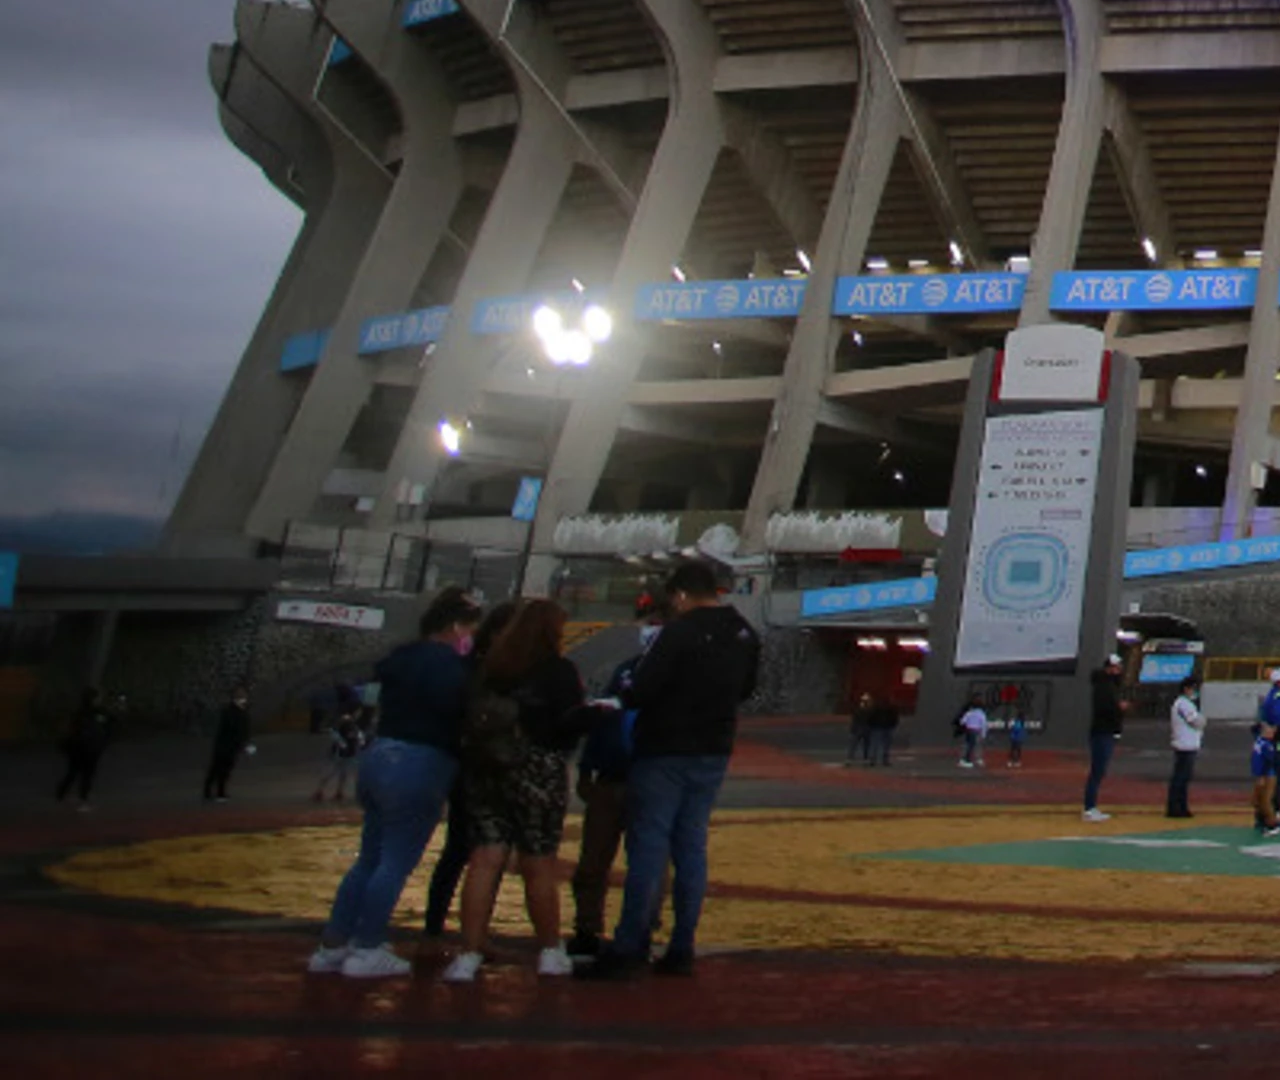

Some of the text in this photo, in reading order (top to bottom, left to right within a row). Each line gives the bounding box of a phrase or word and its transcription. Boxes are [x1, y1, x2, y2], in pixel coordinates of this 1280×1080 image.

[650, 285, 803, 311] AT&T AT&T
[848, 278, 1022, 306] AT&T AT&T
[1067, 275, 1247, 302] AT&T AT&T
